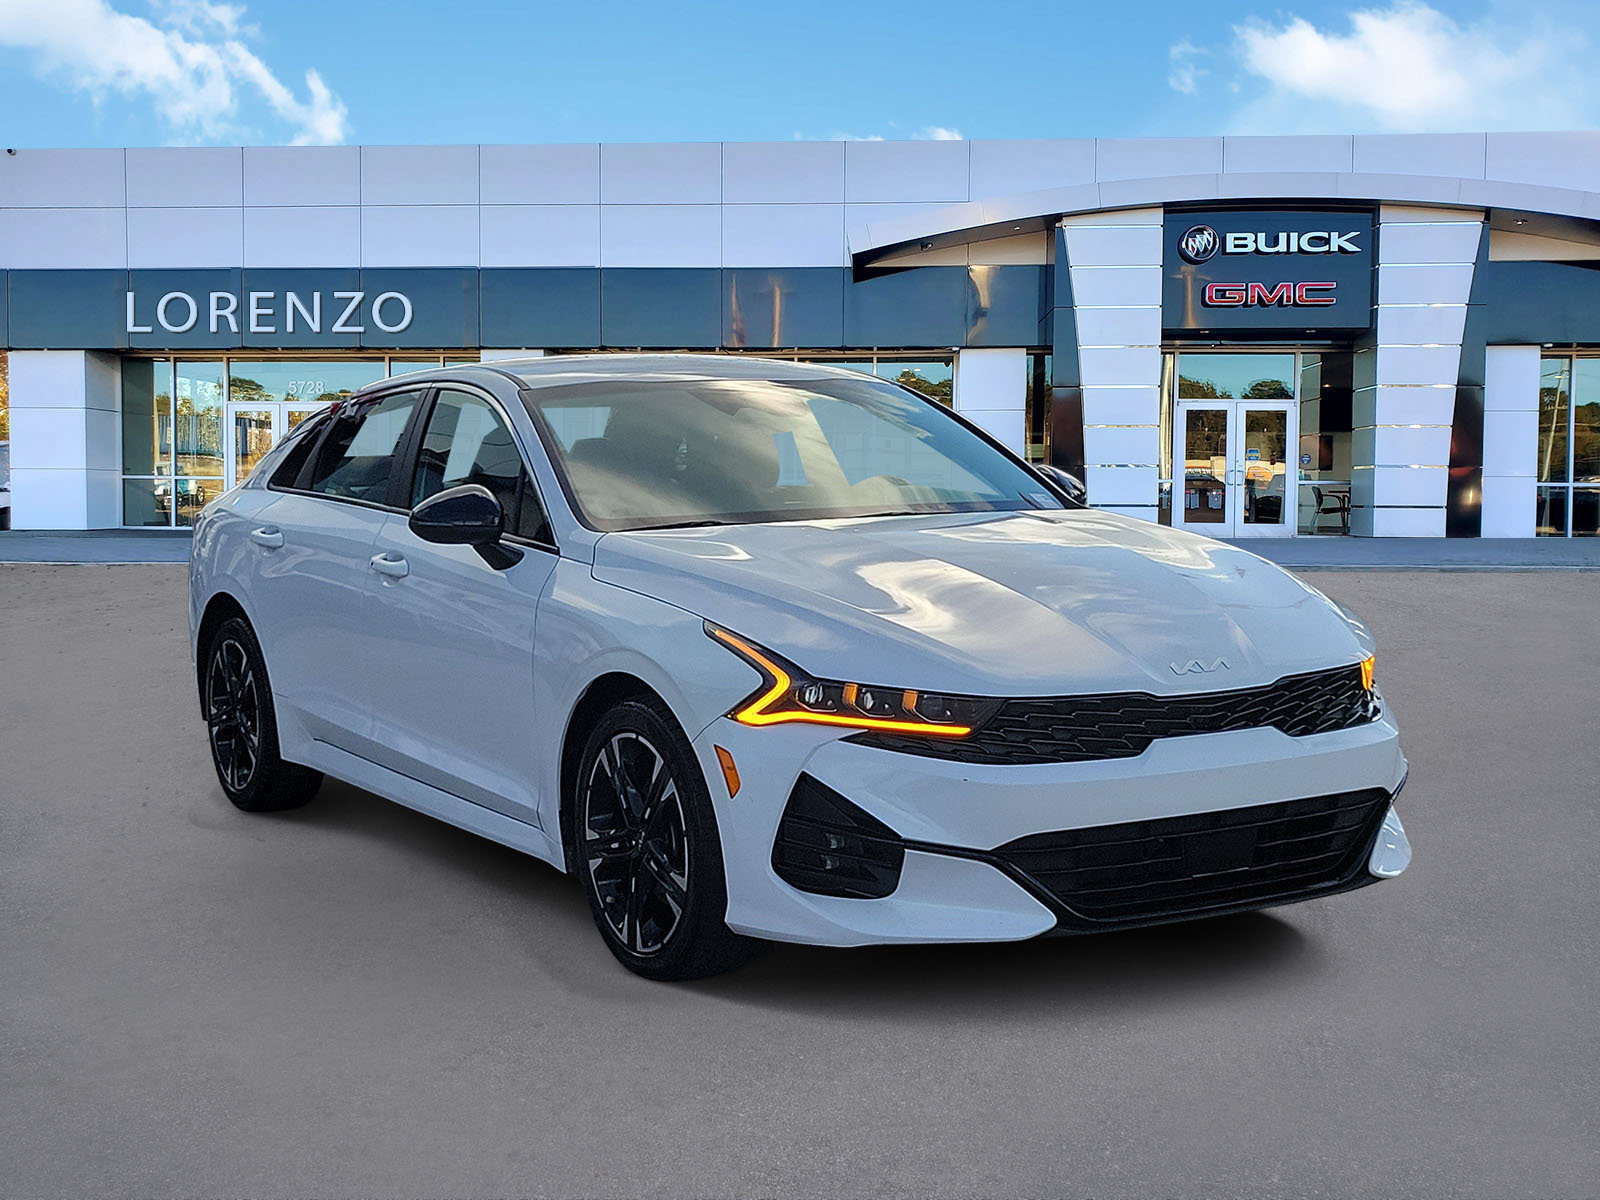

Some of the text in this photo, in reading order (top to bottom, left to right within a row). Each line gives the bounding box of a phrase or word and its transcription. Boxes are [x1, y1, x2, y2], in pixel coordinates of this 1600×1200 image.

[1225, 231, 1362, 254] BUICK
[1205, 282, 1337, 305] GMC
[126, 291, 414, 334] LORENZO
[288, 380, 324, 394] 5728
